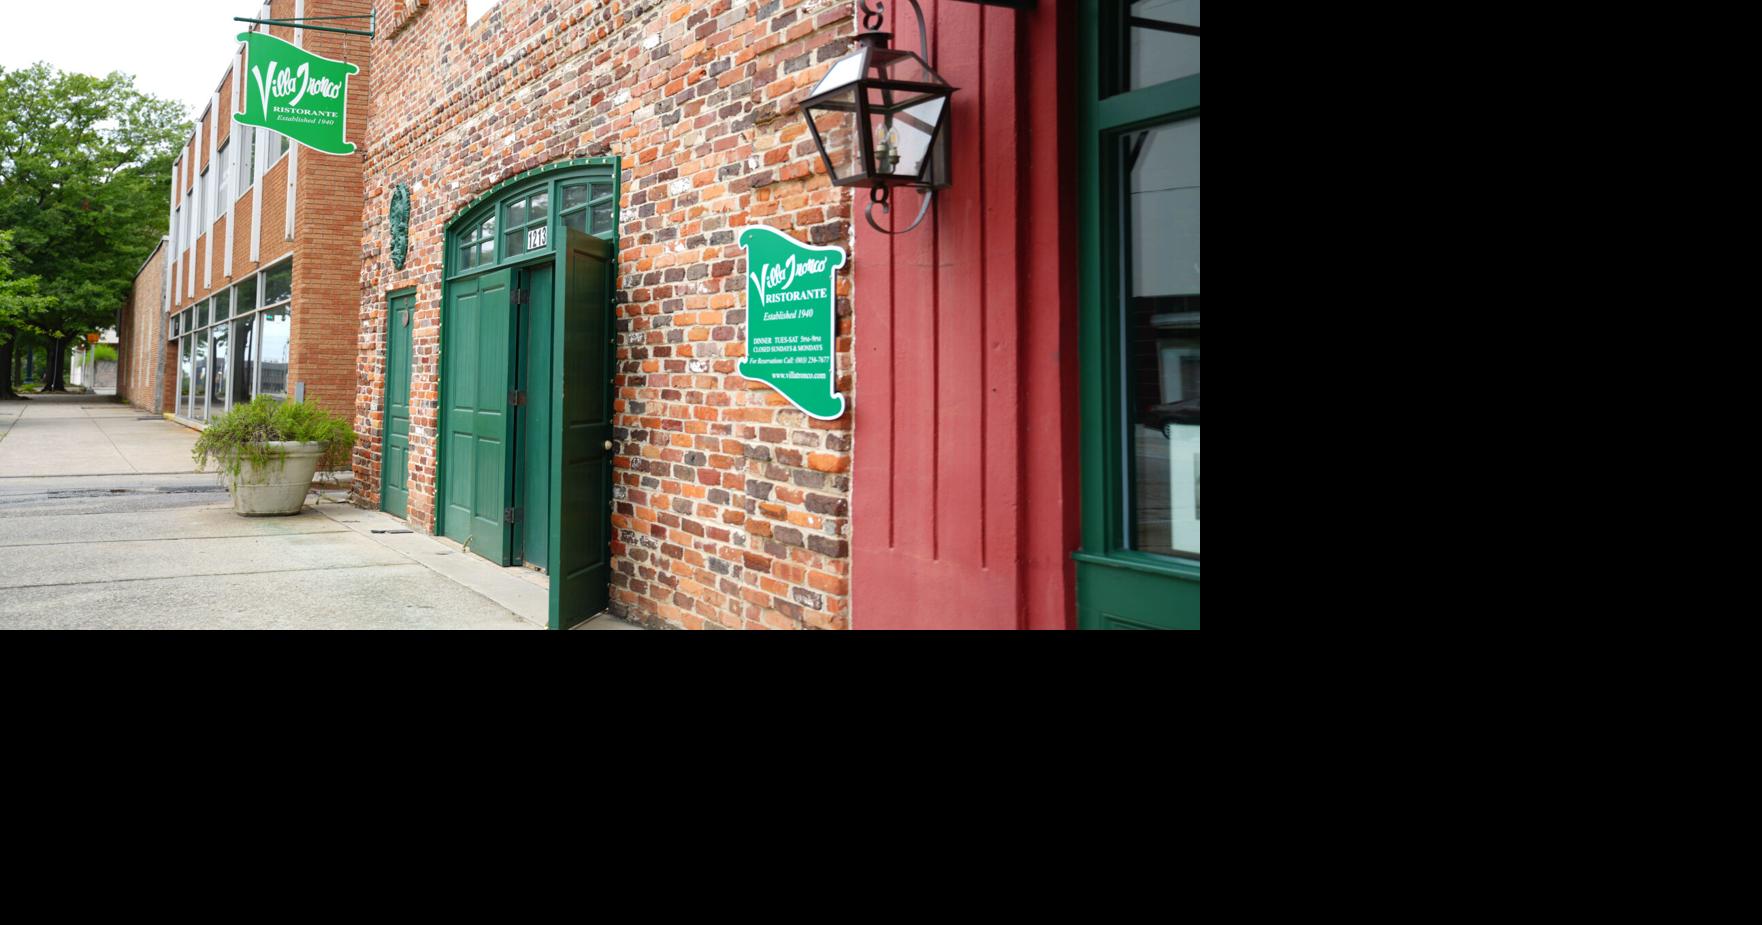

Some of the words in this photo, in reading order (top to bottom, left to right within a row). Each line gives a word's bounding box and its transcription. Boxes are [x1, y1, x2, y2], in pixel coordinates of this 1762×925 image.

[252, 61, 296, 120] Villa
[289, 62, 342, 107] Tronco
[273, 106, 338, 118] RISTORANTE
[277, 115, 316, 124] Established
[529, 227, 547, 249] 1213
[750, 263, 786, 307] Villa
[781, 254, 828, 290] Tronco
[766, 288, 827, 304] RISTORANTE
[763, 310, 797, 321] Established
[798, 309, 814, 319] 1940
[753, 337, 772, 345] DINNER
